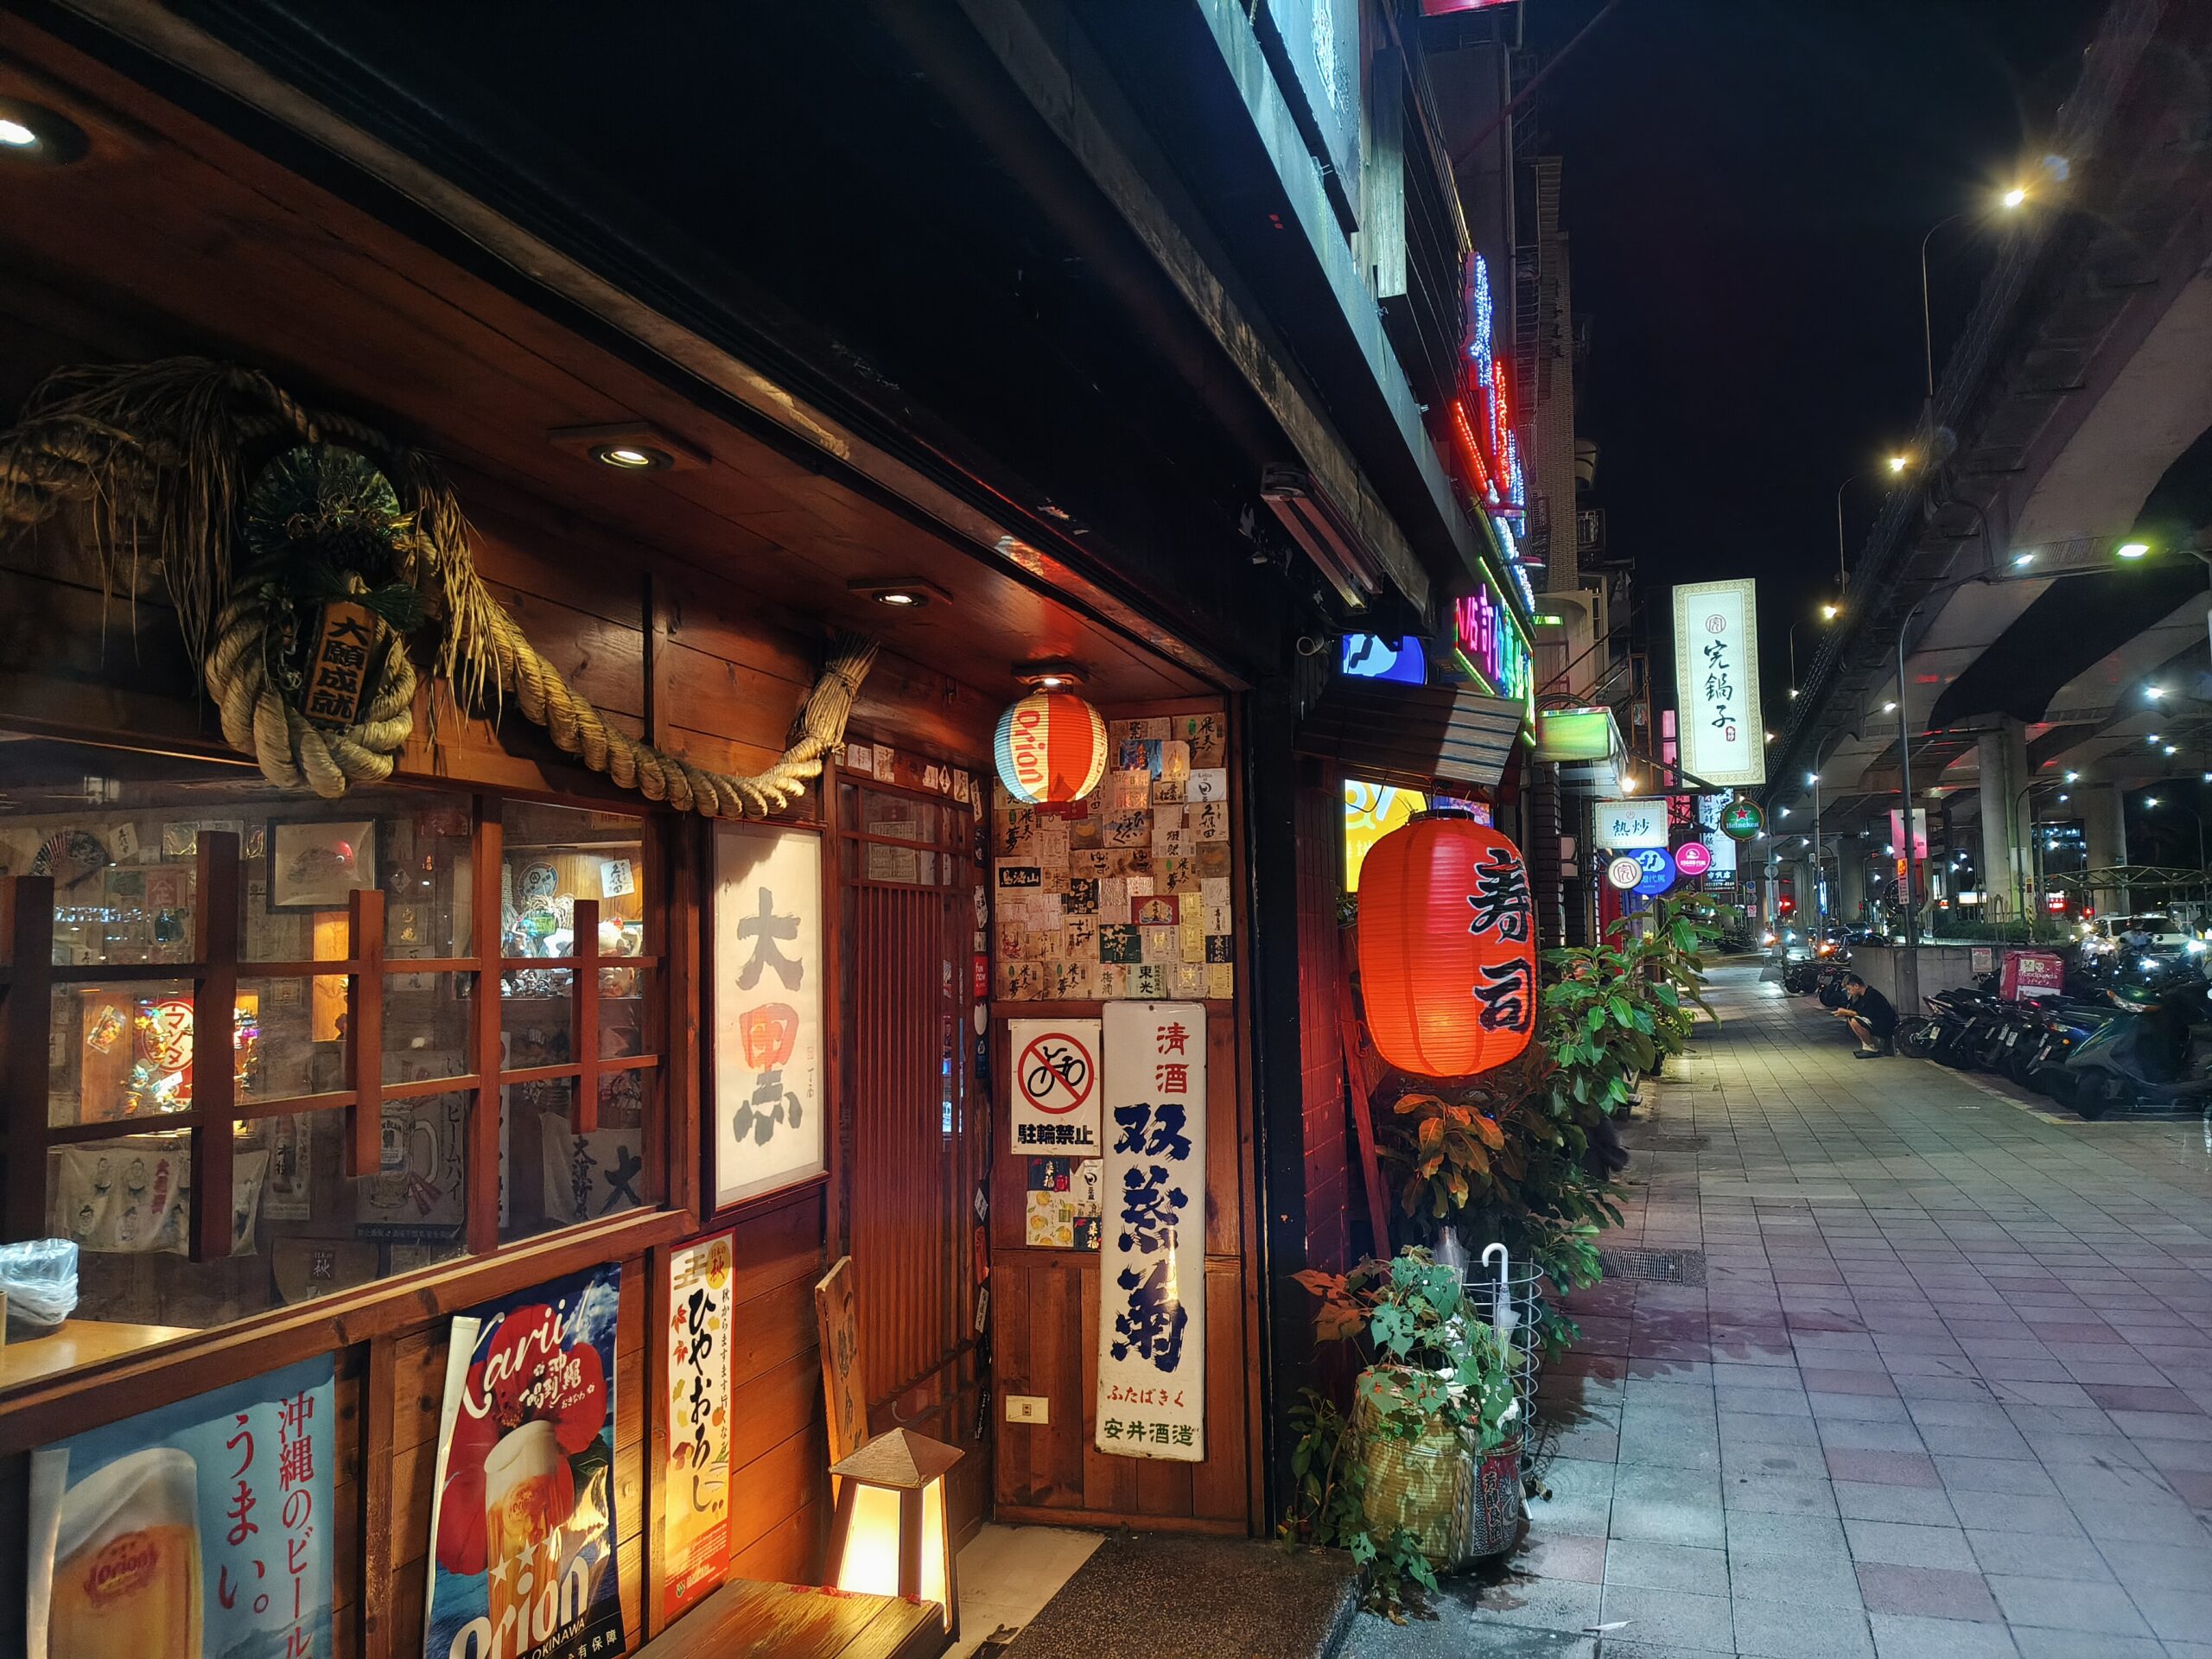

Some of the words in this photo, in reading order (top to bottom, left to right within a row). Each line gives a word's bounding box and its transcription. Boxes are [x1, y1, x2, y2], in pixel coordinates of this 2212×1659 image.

[315, 616, 371, 719] 大願成就
[1704, 639, 1736, 728] 完鍋子
[1016, 710, 1045, 785] Orion
[1612, 818, 1650, 836] 熱炒
[1726, 821, 1760, 830] Heineken
[1468, 847, 1533, 1033] 寿司
[1139, 965, 1154, 995] 東光
[1155, 1023, 1191, 1095] 清酒
[1018, 1124, 1094, 1146] 駐輪禁止
[561, 1392, 586, 1410] おきなわ
[688, 1287, 717, 1513] ひやおろし
[1107, 1384, 1185, 1408] ふたばきく
[1103, 1417, 1194, 1446] 安井酒造
[278, 1391, 315, 1659] 沖縄のビール
